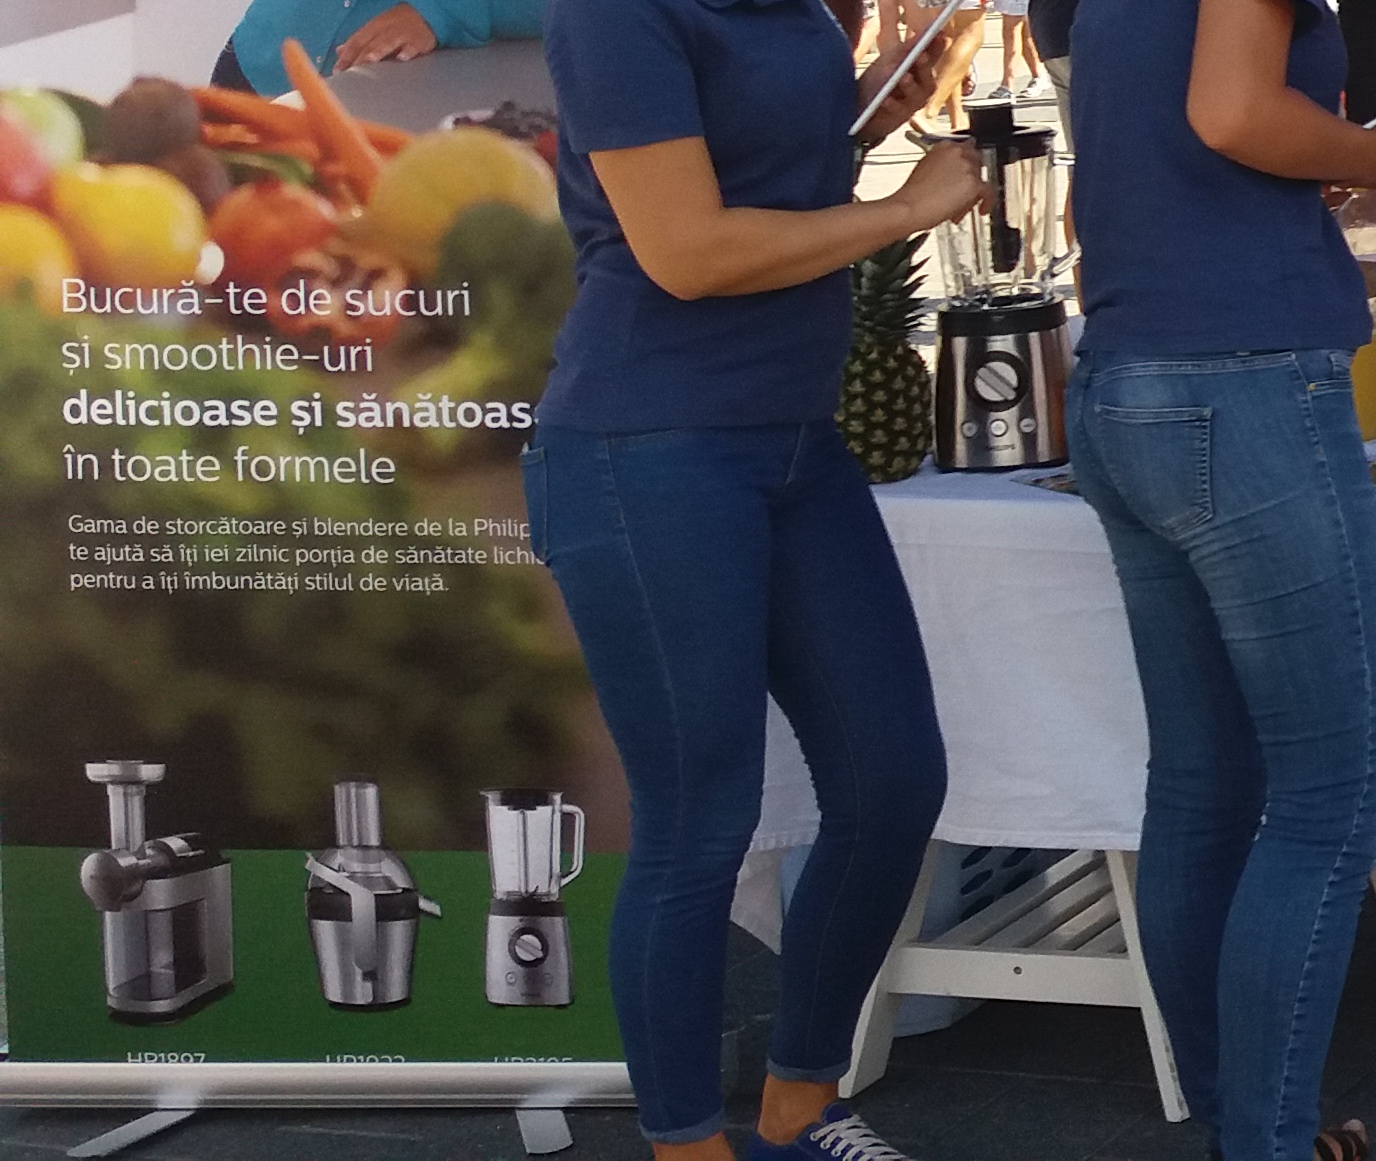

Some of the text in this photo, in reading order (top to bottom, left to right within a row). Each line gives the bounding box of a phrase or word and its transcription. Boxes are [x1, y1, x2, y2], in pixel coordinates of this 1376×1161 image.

[62, 277, 471, 317] Bucură-te de sucuri
[61, 334, 373, 376] și smoothie-uri
[62, 388, 538, 435] delicioase și sănătoas
[62, 443, 396, 484] în toate formele
[67, 514, 128, 536] Gama
[132, 515, 160, 536] de
[165, 516, 287, 536] storcătoare
[313, 516, 408, 537] blendere
[414, 517, 442, 537] de
[448, 517, 468, 537] la
[473, 517, 532, 541] Philip
[68, 542, 90, 562] te
[94, 542, 145, 566] ajută
[150, 543, 174, 563] să
[203, 543, 229, 563] iei
[235, 543, 290, 564] zilnic
[361, 544, 389, 565] de
[394, 545, 488, 566] sănătate
[493, 545, 545, 566] lichi
[70, 571, 136, 592] pentru
[141, 575, 156, 591] a
[304, 572, 355, 592] stilul
[359, 572, 388, 592] de
